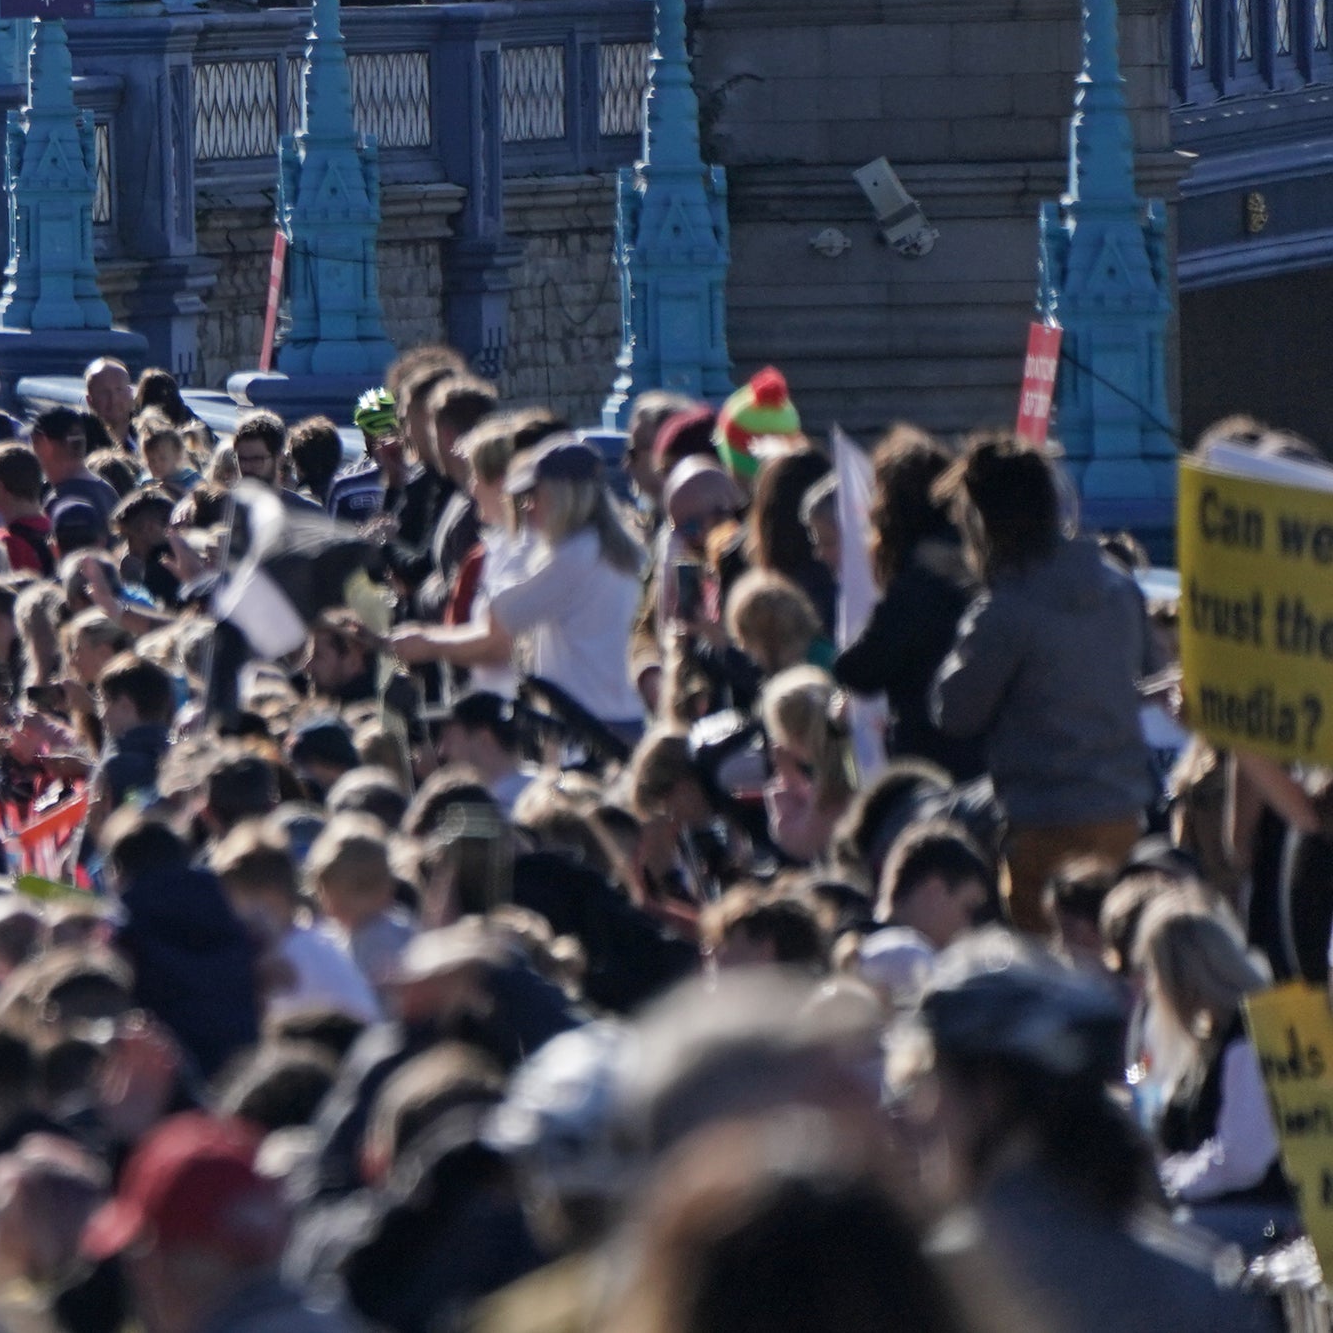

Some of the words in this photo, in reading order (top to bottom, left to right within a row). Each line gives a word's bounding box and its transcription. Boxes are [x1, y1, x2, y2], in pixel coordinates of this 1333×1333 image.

[1199, 486, 1263, 551] Can
[1190, 578, 1263, 645] trust
[1201, 682, 1322, 753] media?
